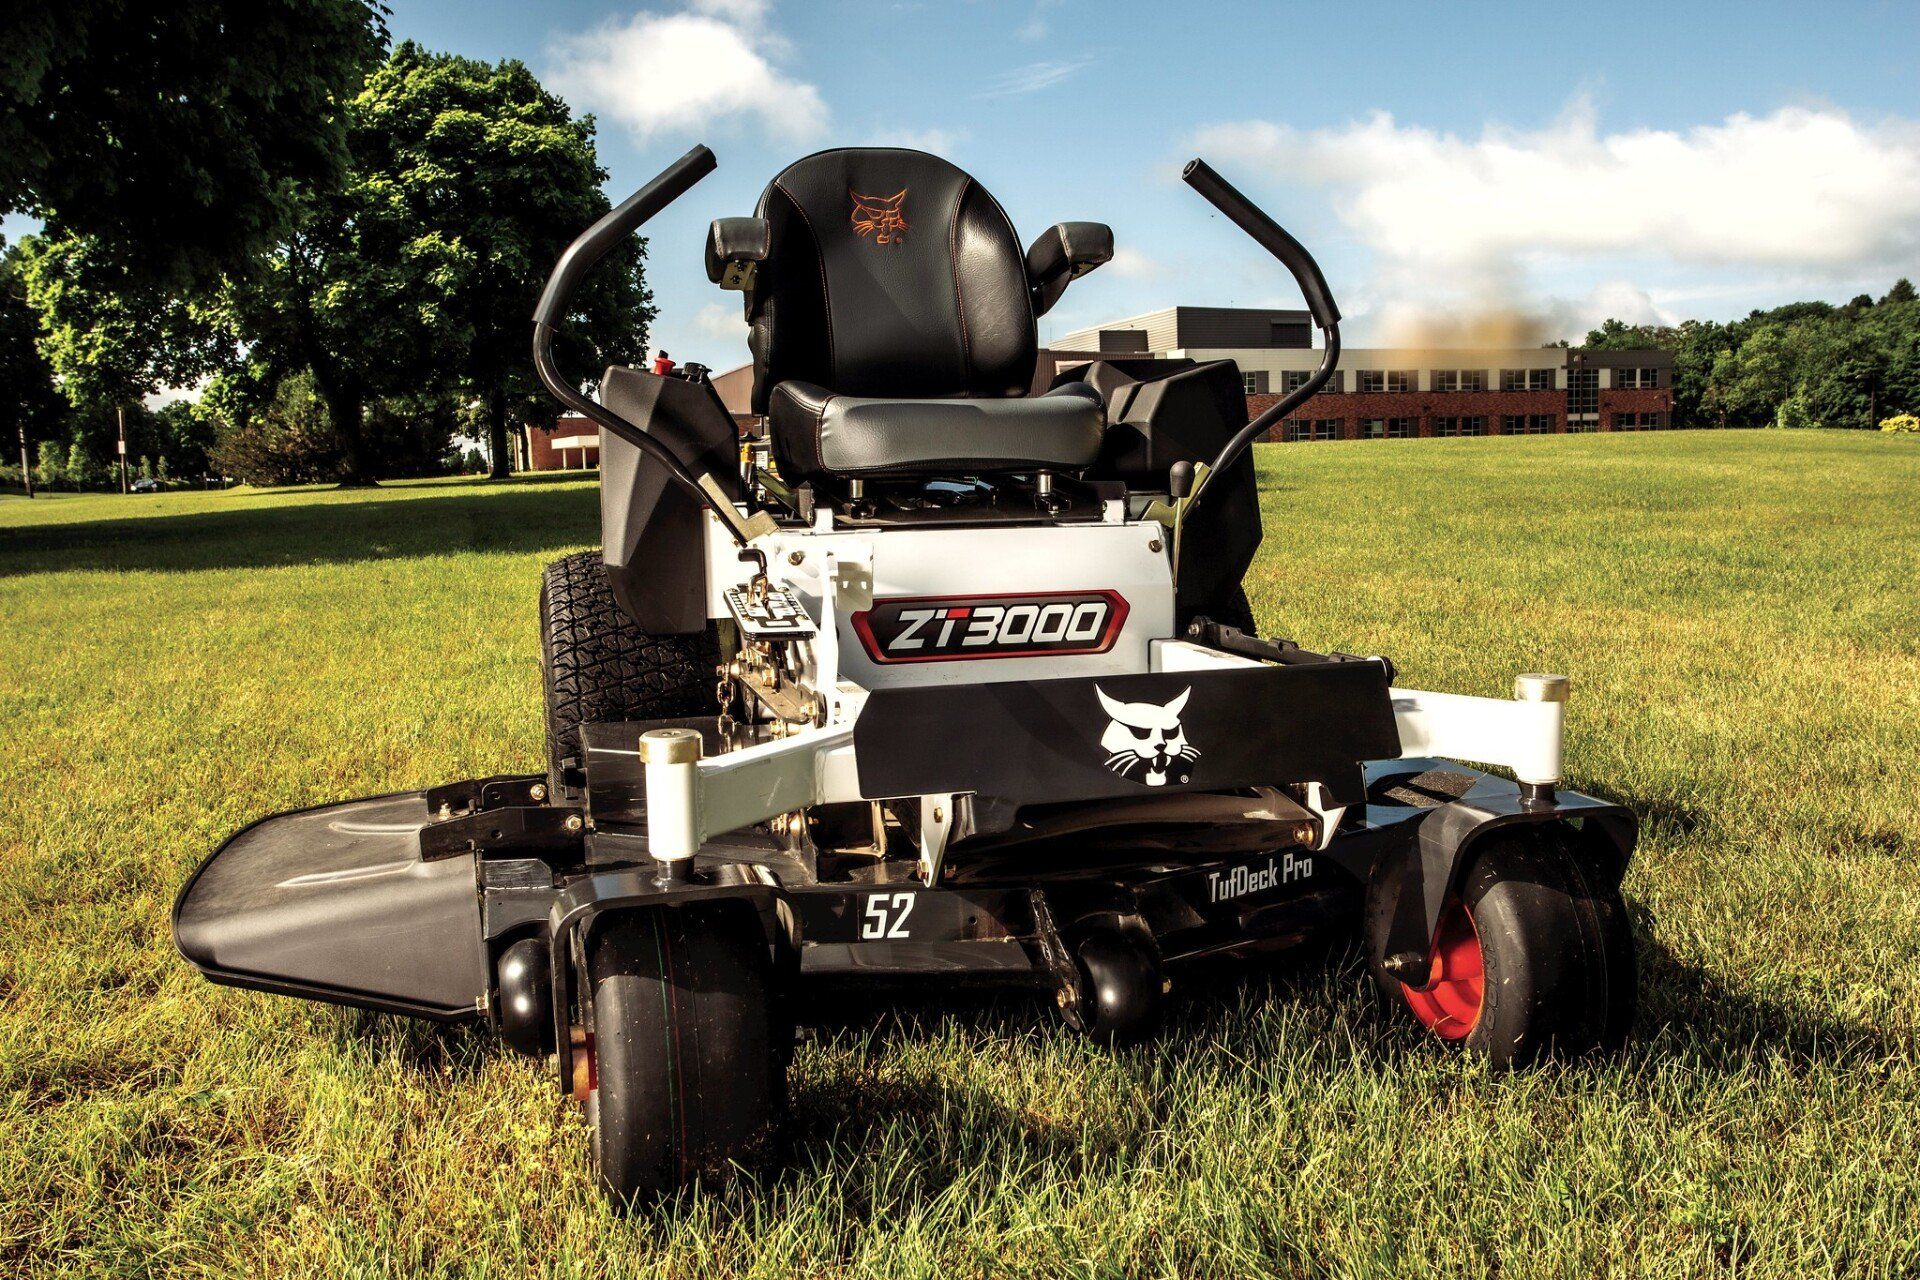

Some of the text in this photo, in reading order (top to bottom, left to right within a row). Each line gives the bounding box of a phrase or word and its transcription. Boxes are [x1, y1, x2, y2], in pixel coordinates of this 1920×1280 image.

[888, 602, 1108, 650] ZT3000
[1209, 853, 1313, 903] TufDeck Pro
[862, 892, 915, 939] 52
